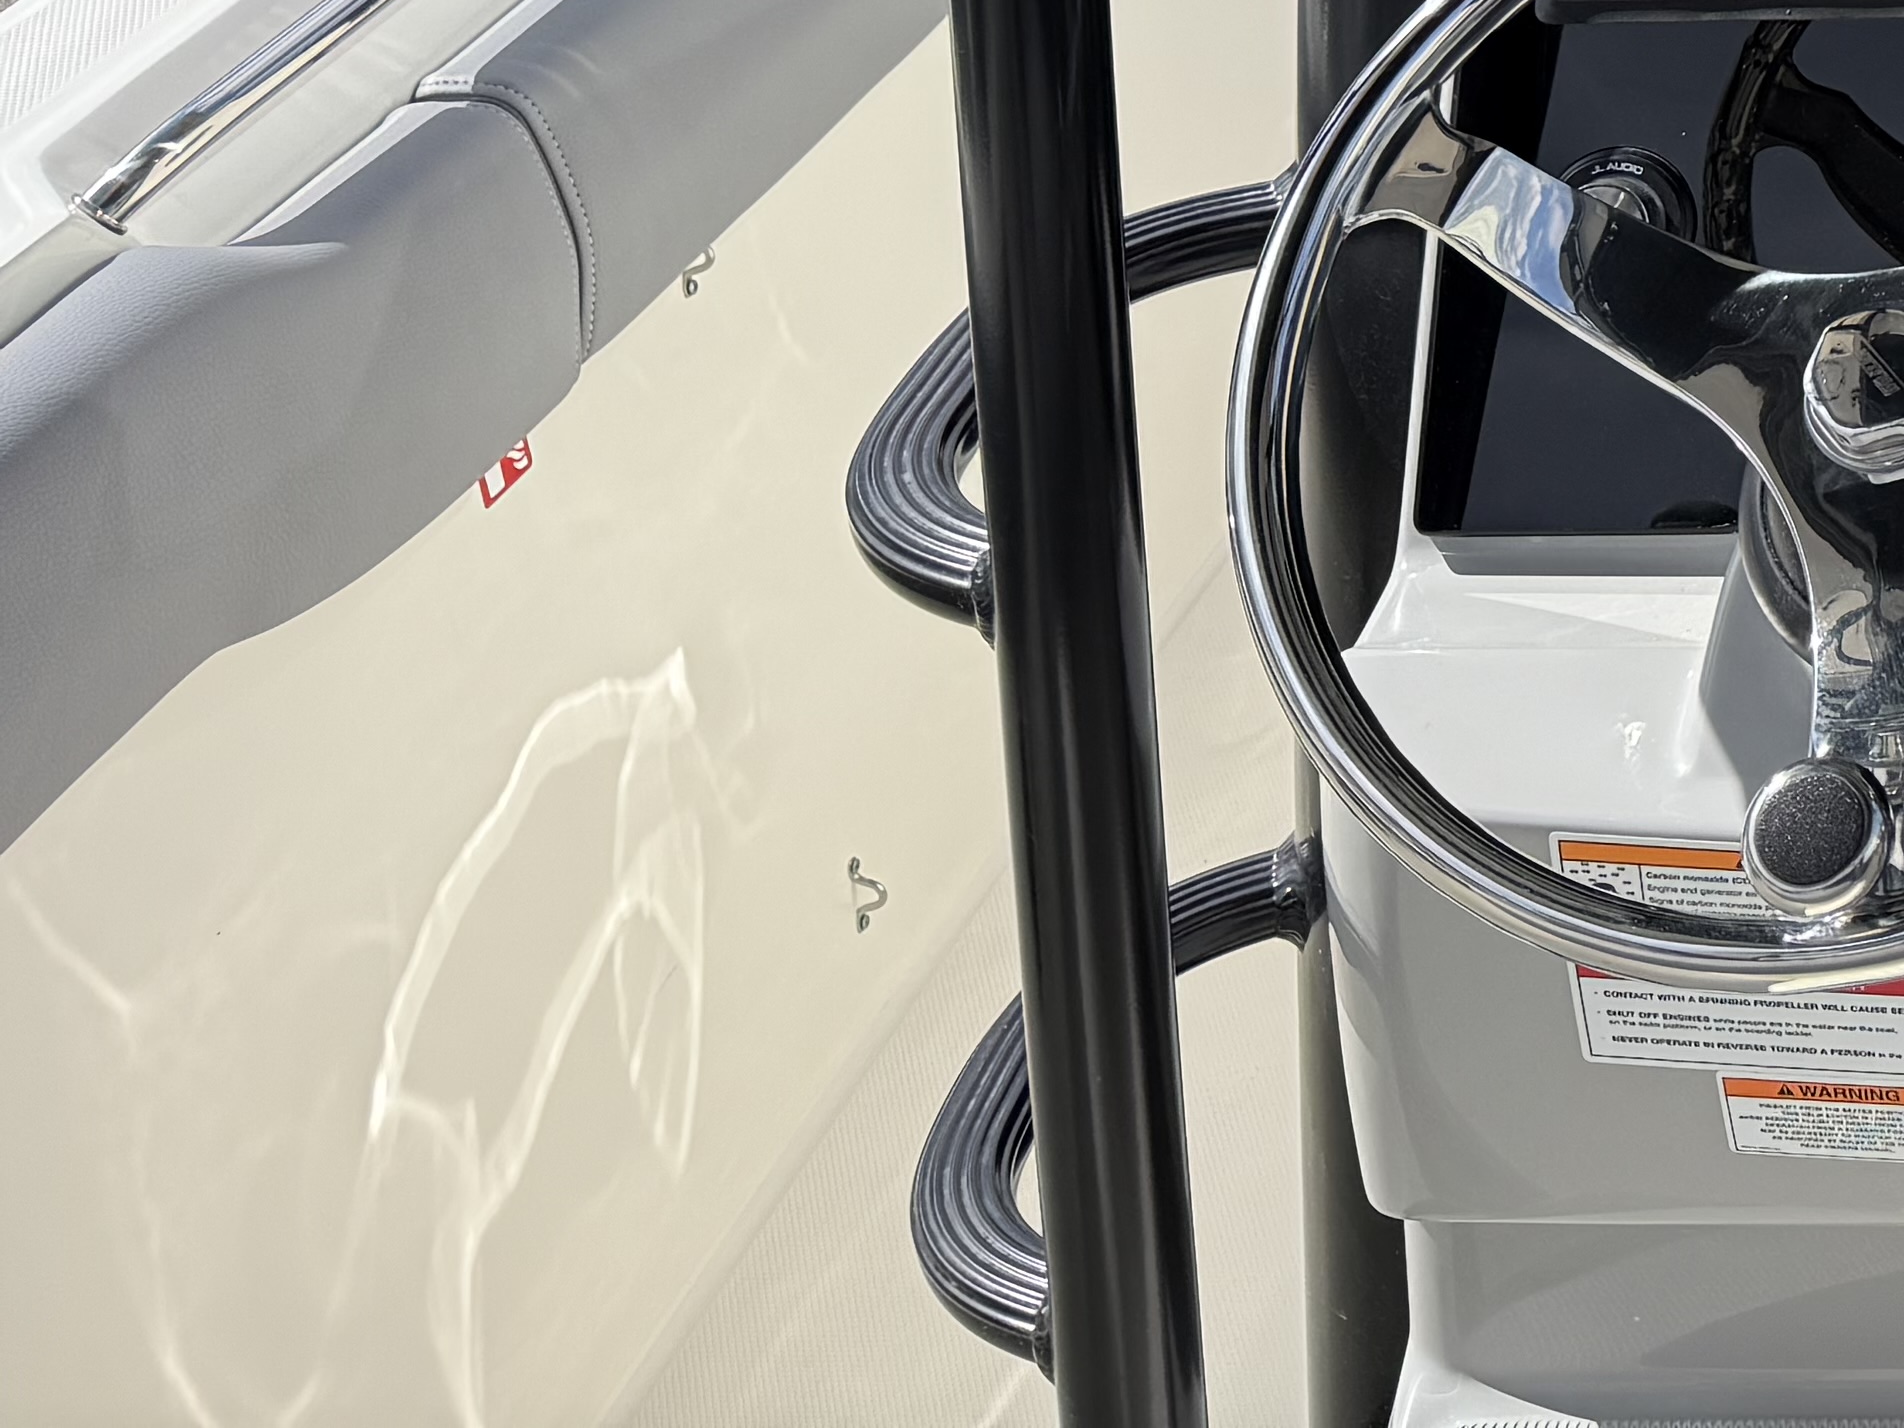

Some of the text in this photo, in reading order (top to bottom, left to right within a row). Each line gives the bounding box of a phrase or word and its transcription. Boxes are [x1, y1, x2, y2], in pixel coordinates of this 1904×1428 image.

[1606, 162, 1644, 175] AUDIO
[1645, 871, 1681, 881] Carbon
[1603, 990, 1654, 1001] CONTACT
[1657, 994, 1686, 1003] WITH
[1688, 995, 1696, 1003] A
[1753, 998, 1819, 1011] PROPELLER
[1820, 1003, 1848, 1012] WILL
[1849, 1005, 1888, 1015] CAUSE
[1606, 1009, 1635, 1019] SHUT
[1638, 1011, 1660, 1020] OFF
[1650, 1037, 1700, 1048] OPERATE
[1770, 1045, 1818, 1055] TOWARD
[1798, 1085, 1901, 1102] WARNING
